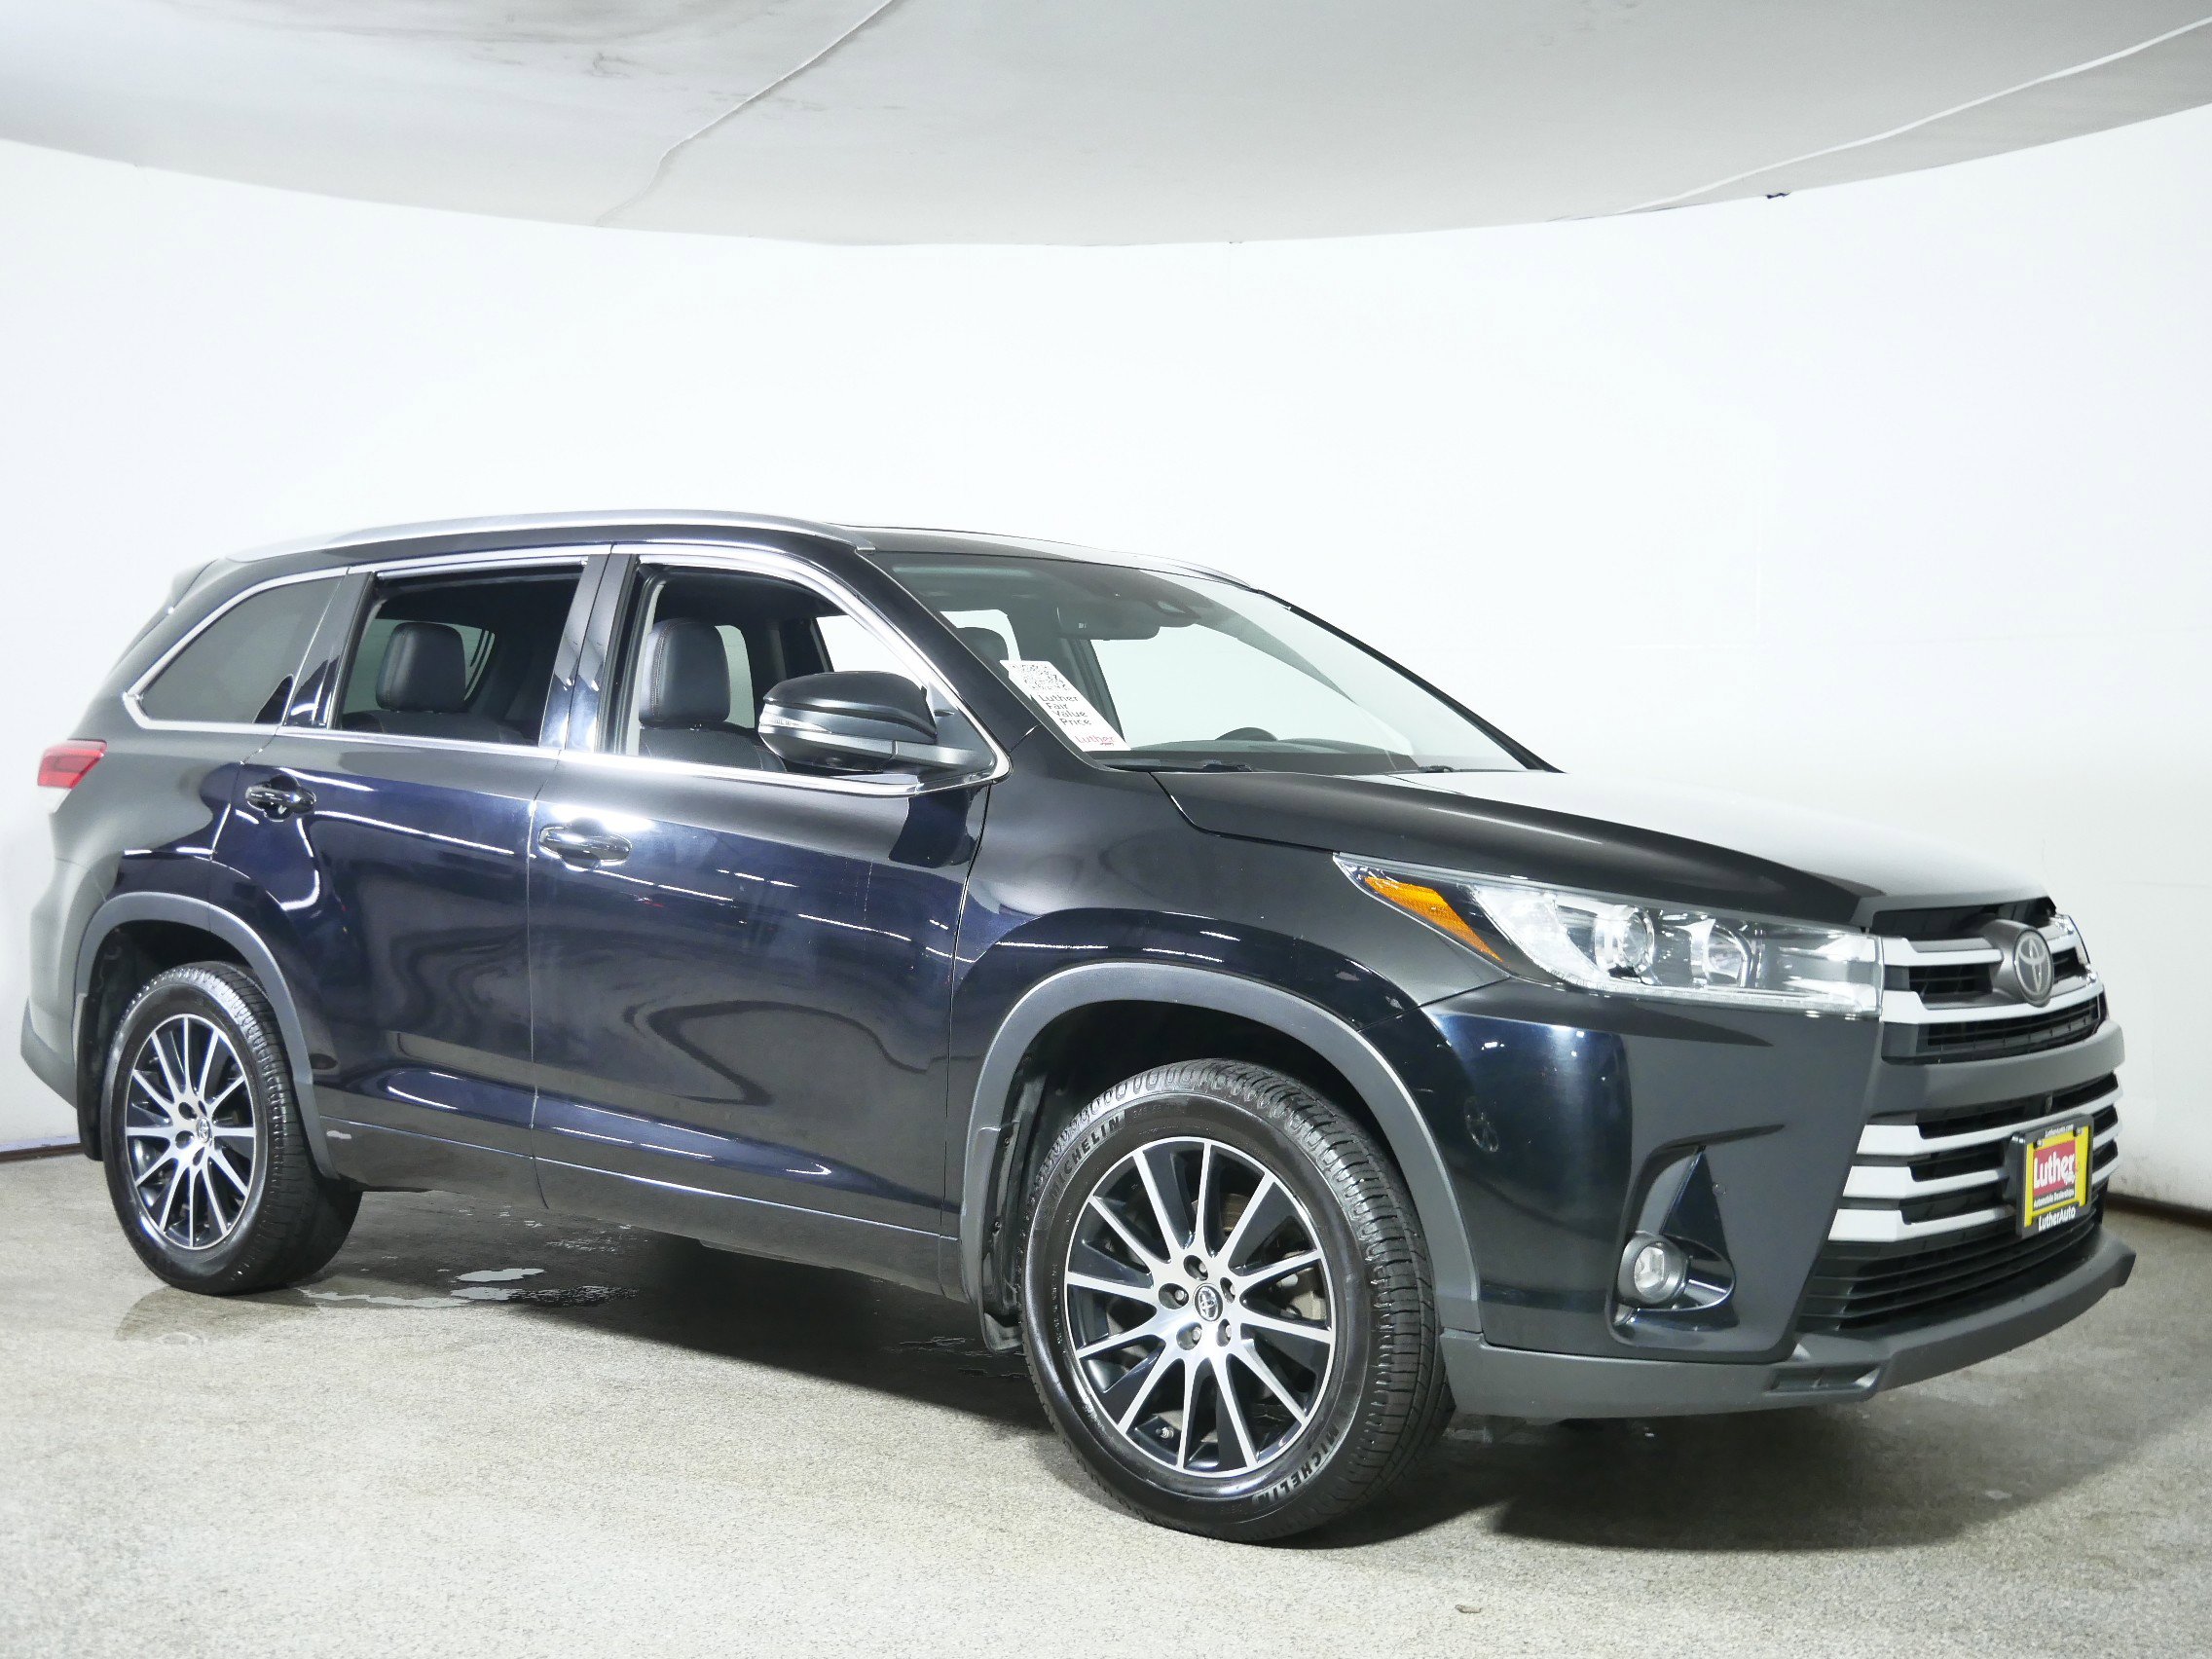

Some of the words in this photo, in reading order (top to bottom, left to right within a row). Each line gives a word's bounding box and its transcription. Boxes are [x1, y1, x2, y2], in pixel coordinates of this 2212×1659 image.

[1038, 694, 1079, 703] Luther
[1059, 718, 1092, 726] Price
[1075, 735, 1116, 744] Luther
[1049, 1115, 1122, 1200] MICHELIN
[2034, 1151, 2076, 1189] Luther
[2038, 1205, 2076, 1232] LutherAuto
[1256, 1423, 1340, 1505] MICHELIN
